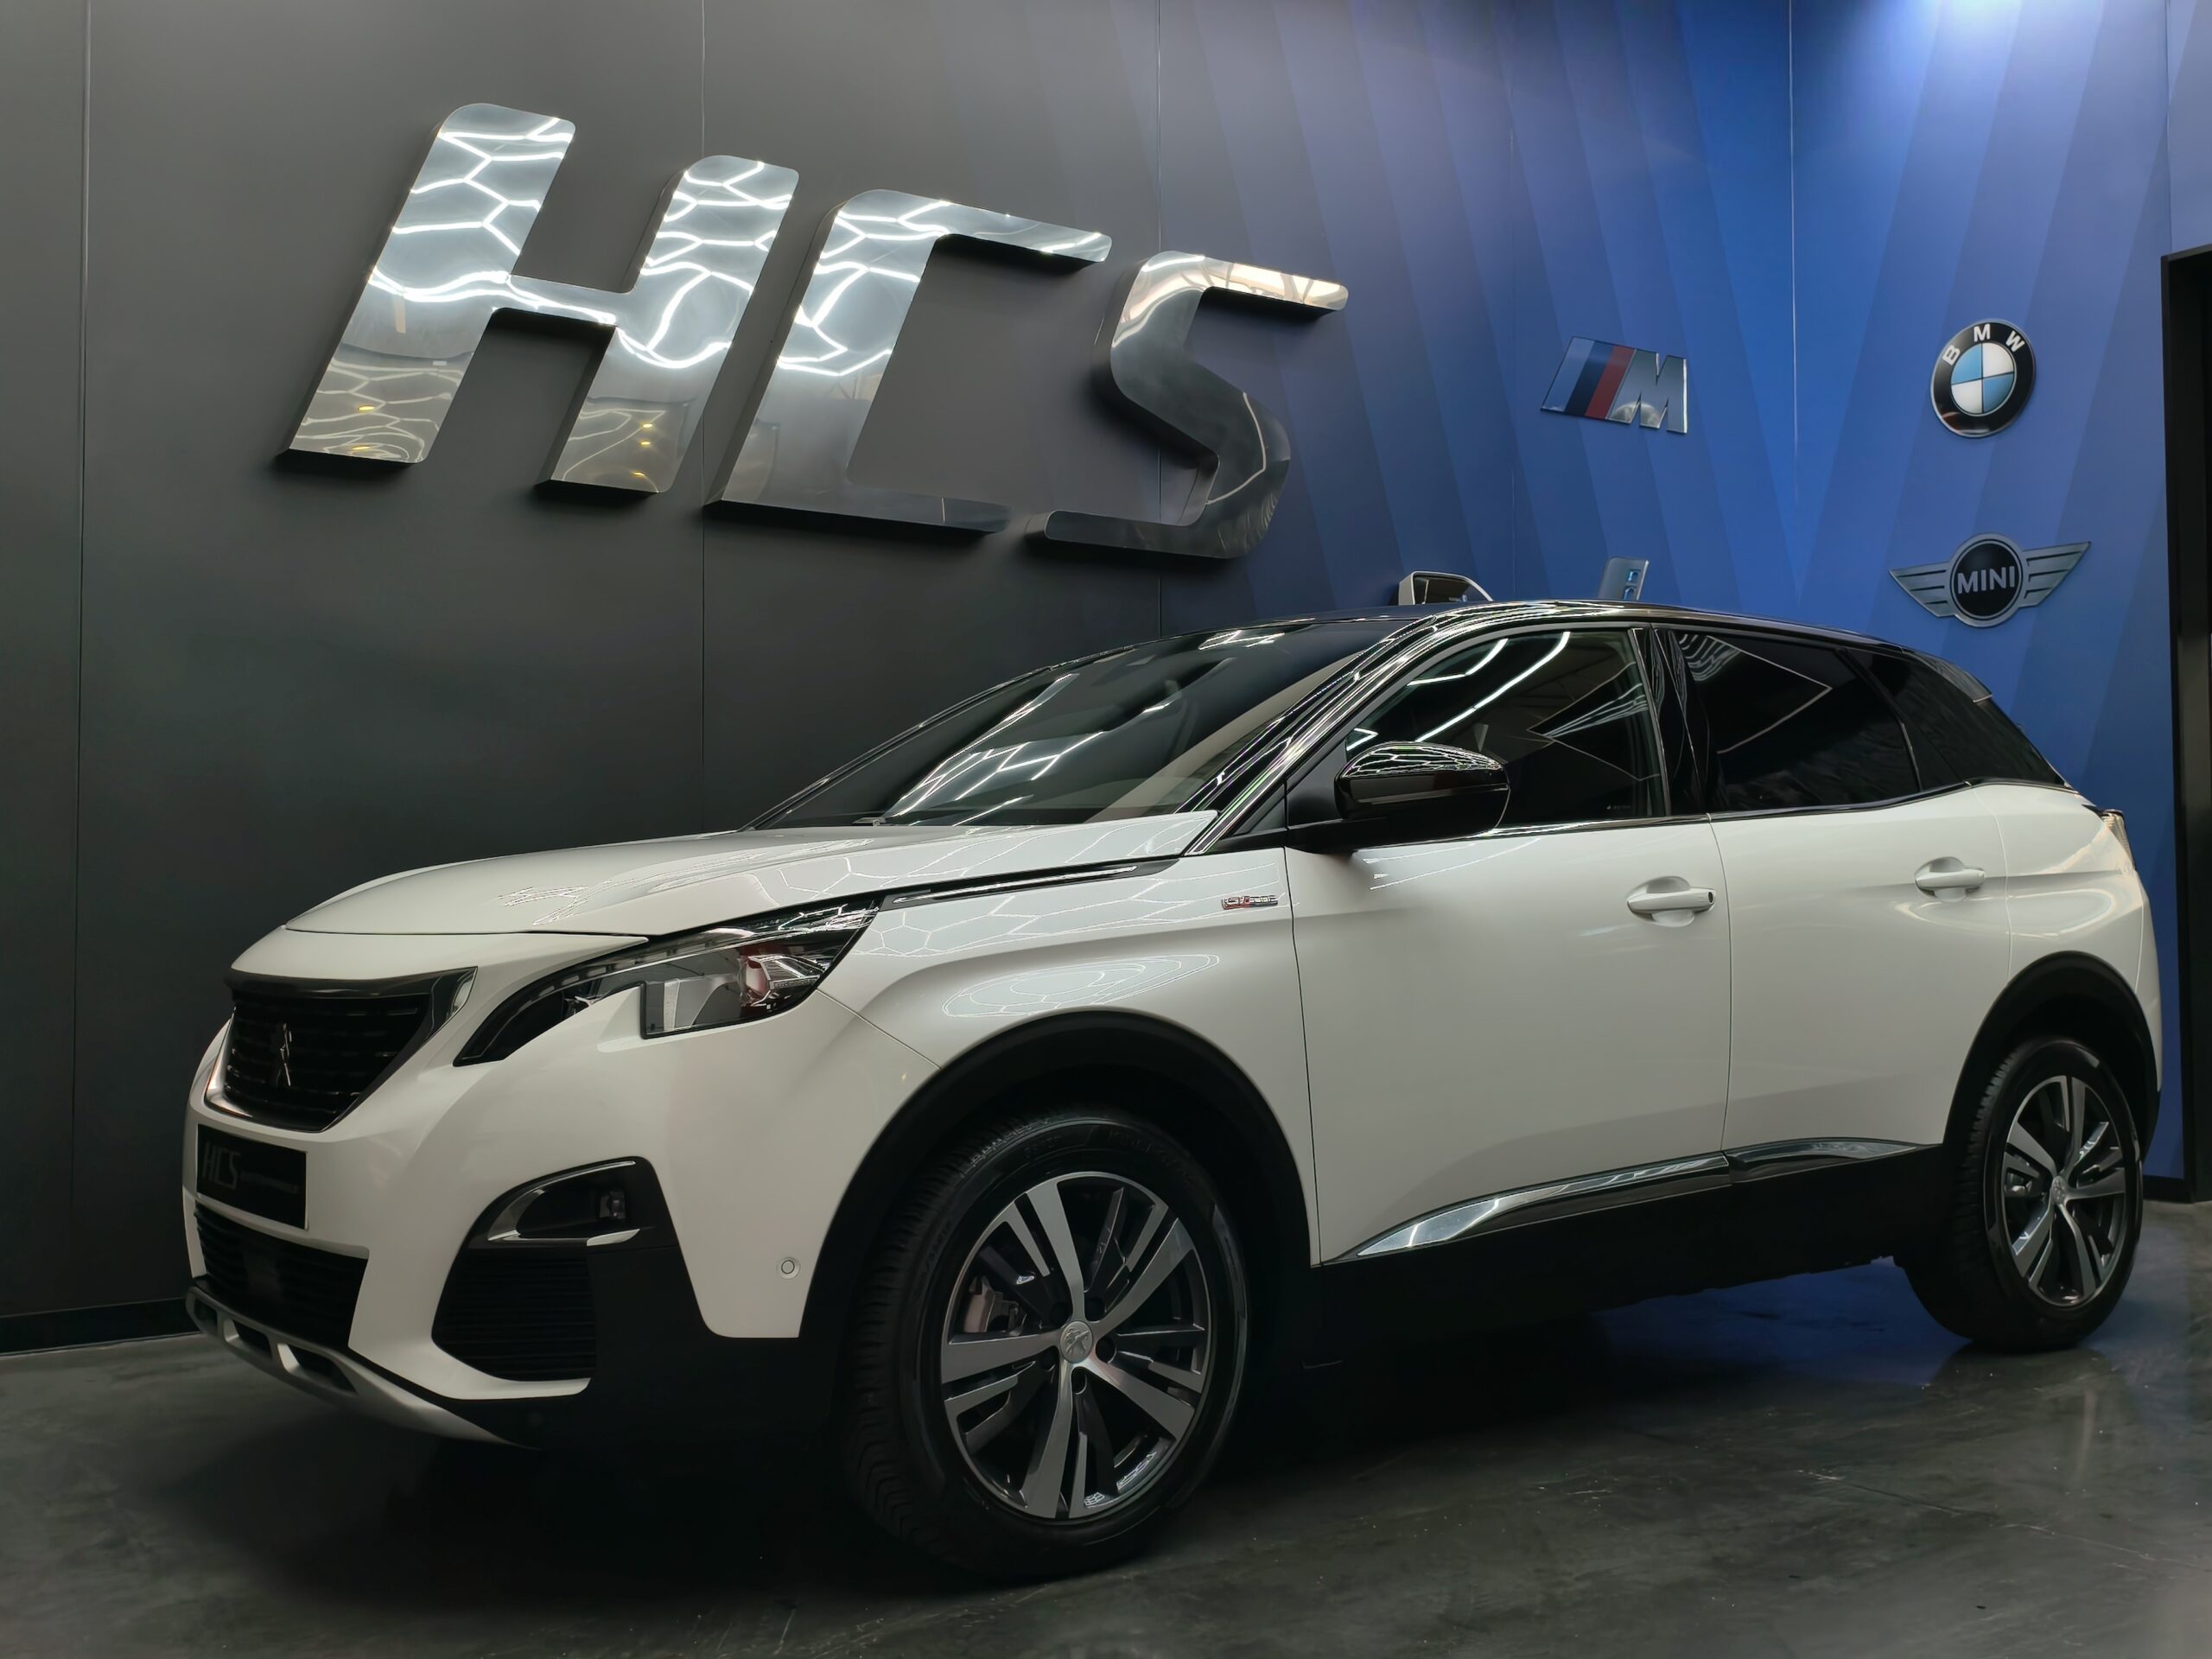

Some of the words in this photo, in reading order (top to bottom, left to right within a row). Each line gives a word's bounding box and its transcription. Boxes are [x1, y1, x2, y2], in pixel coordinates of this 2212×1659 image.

[282, 103, 1349, 559] HCS
[1942, 323, 2025, 365] BMW
[1605, 347, 1688, 435] M
[1957, 566, 2015, 594] MINI
[201, 1141, 242, 1191] HCS
